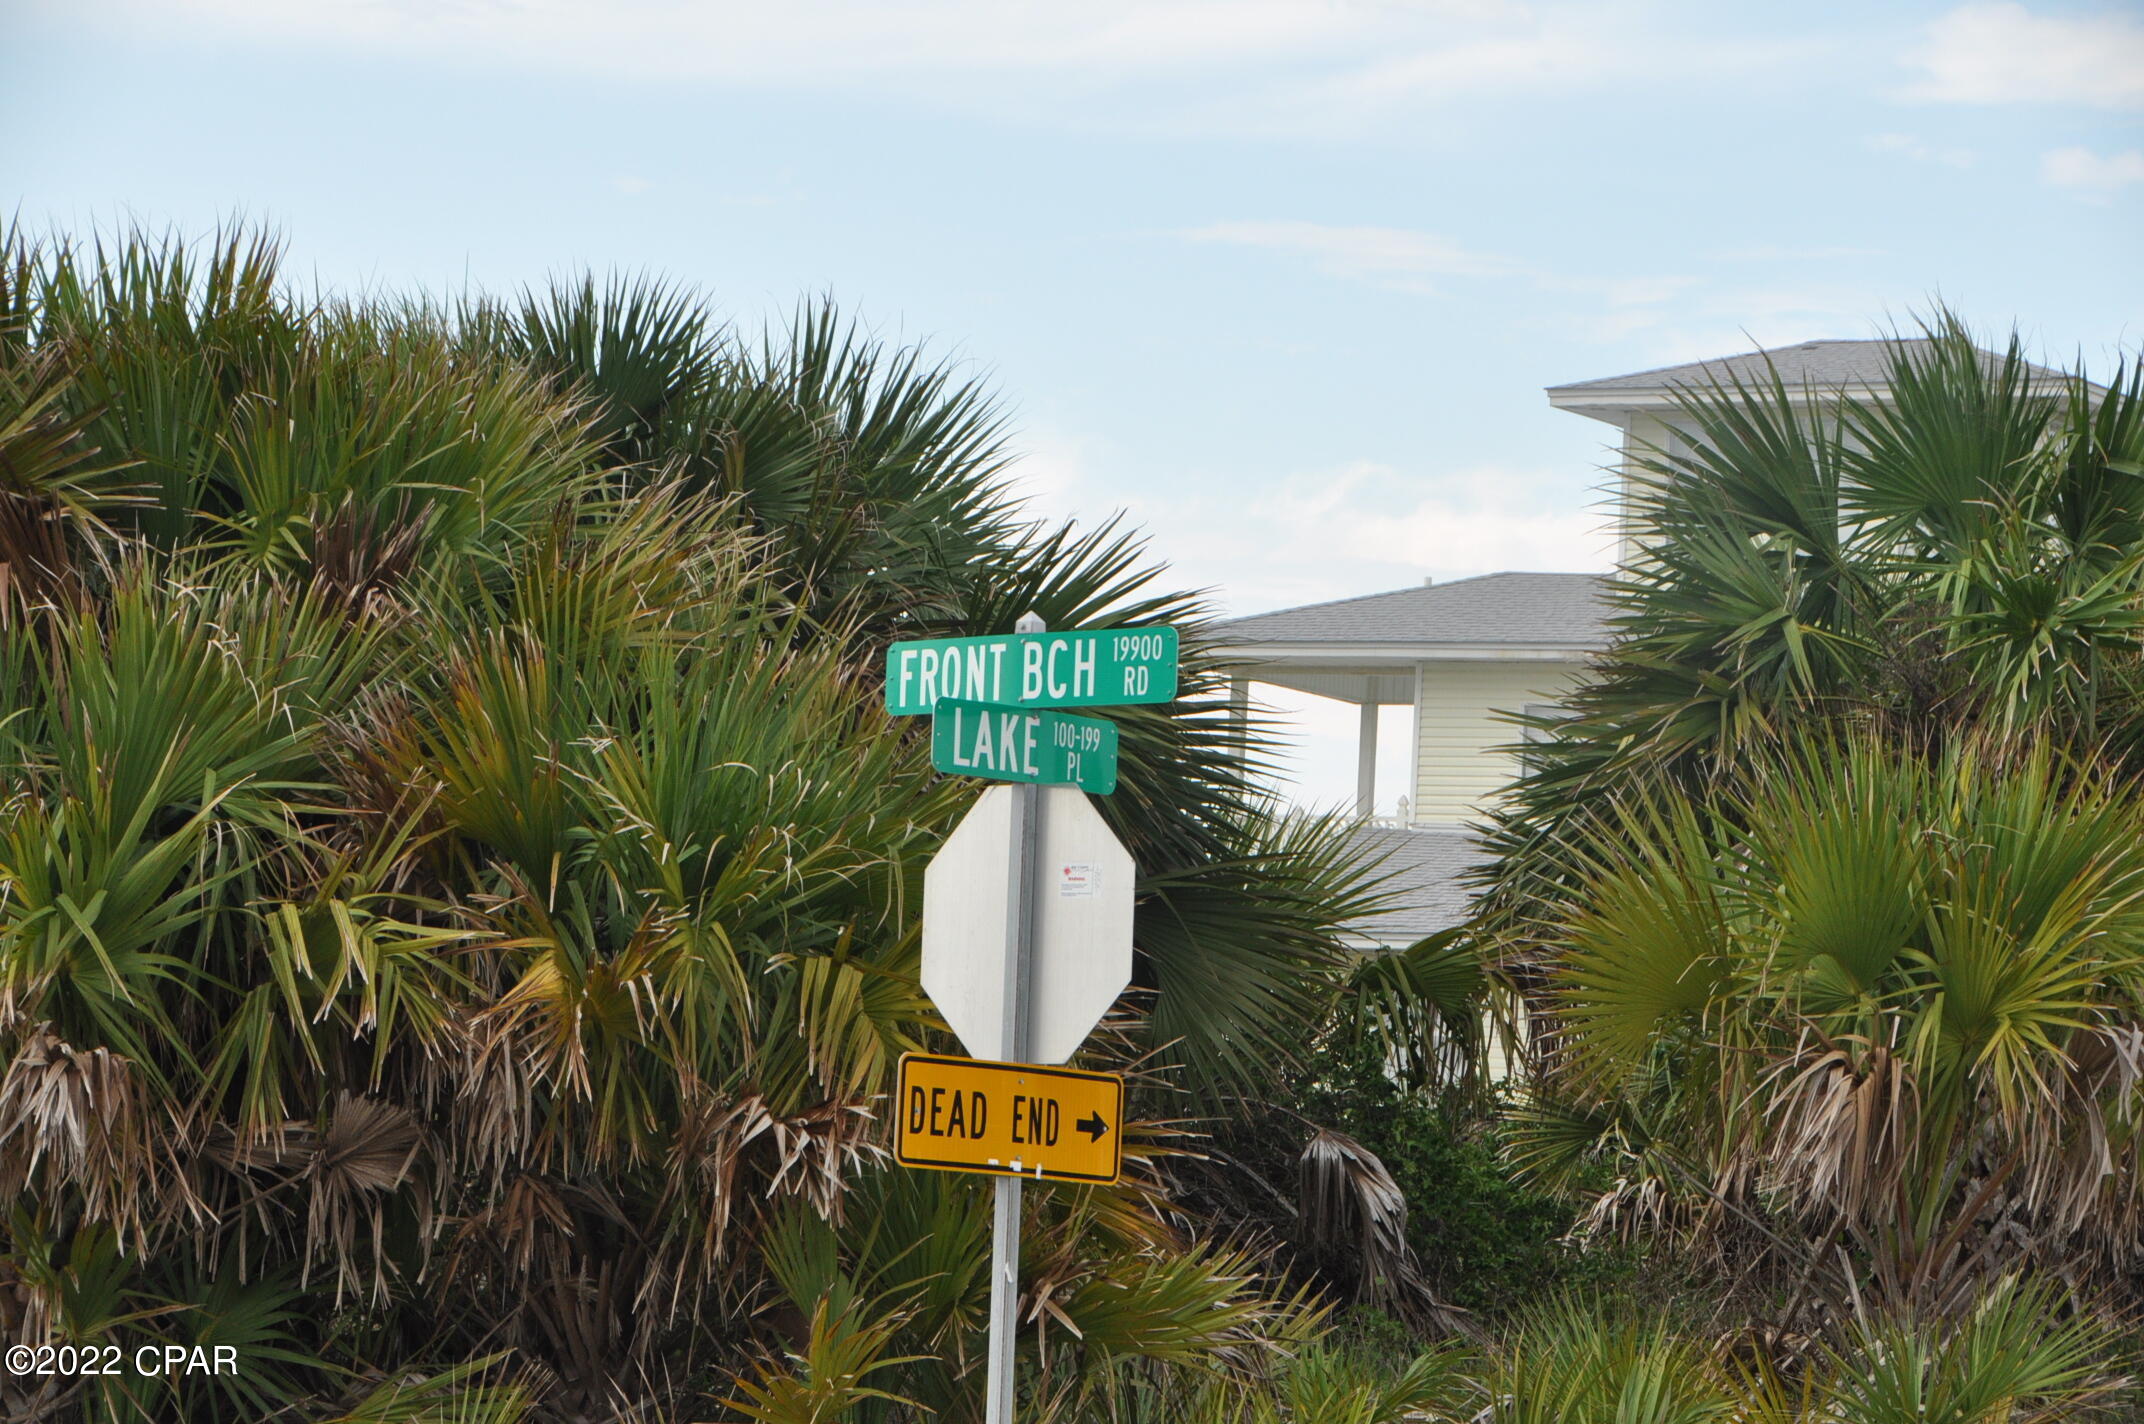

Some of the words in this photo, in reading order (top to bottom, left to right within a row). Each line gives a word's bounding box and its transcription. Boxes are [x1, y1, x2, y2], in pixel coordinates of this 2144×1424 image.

[1113, 634, 1163, 662] 19900
[899, 643, 1007, 708] FRONT
[1022, 638, 1096, 700] BCH
[1123, 665, 1149, 696] RD
[953, 707, 1041, 777] LAKE
[1053, 721, 1101, 753] 100-199
[1066, 751, 1084, 783] PL
[909, 1085, 987, 1140] DEAD
[1012, 1095, 1059, 1147] END
